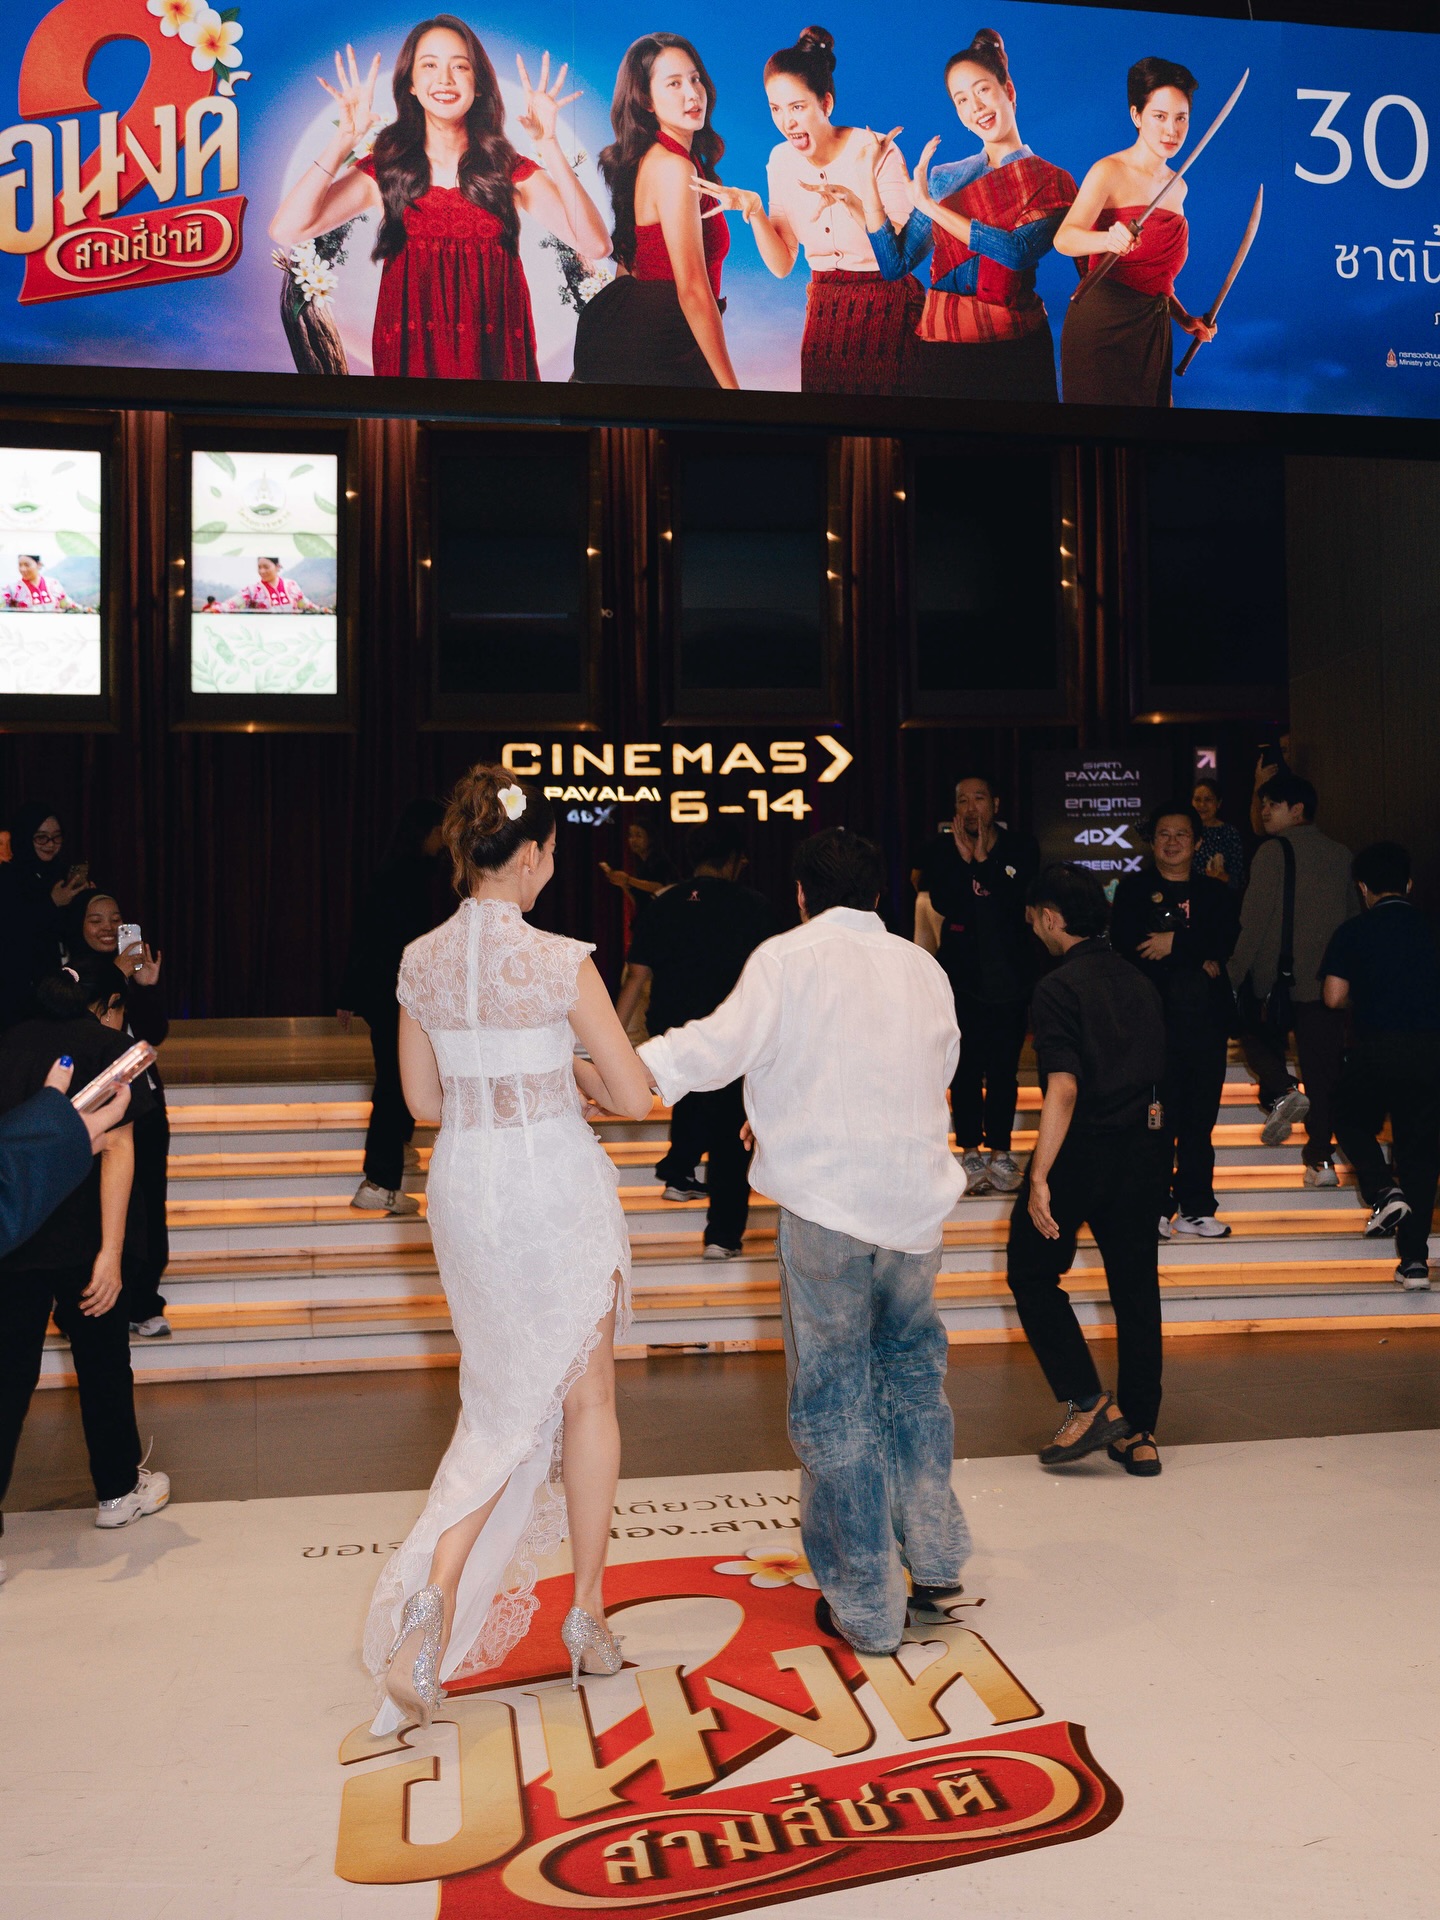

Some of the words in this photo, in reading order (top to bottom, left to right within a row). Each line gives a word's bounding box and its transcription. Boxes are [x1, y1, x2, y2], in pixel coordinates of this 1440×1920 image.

[1294, 87, 1430, 190] 30
[0, 70, 252, 255] อนงค์
[75, 218, 205, 271] สามสี่ชาติ
[1398, 358, 1424, 367] Ministry
[501, 741, 808, 777] CINEMAS
[1065, 770, 1141, 782] PAVALAI
[543, 785, 662, 802] PAVALAI
[1065, 797, 1142, 812] enigma
[1073, 824, 1134, 850] 4DX
[1066, 855, 1144, 873] REENX
[334, 1597, 1045, 1885] อนงค์
[601, 1766, 1000, 1885] สามสี่ชาติ
